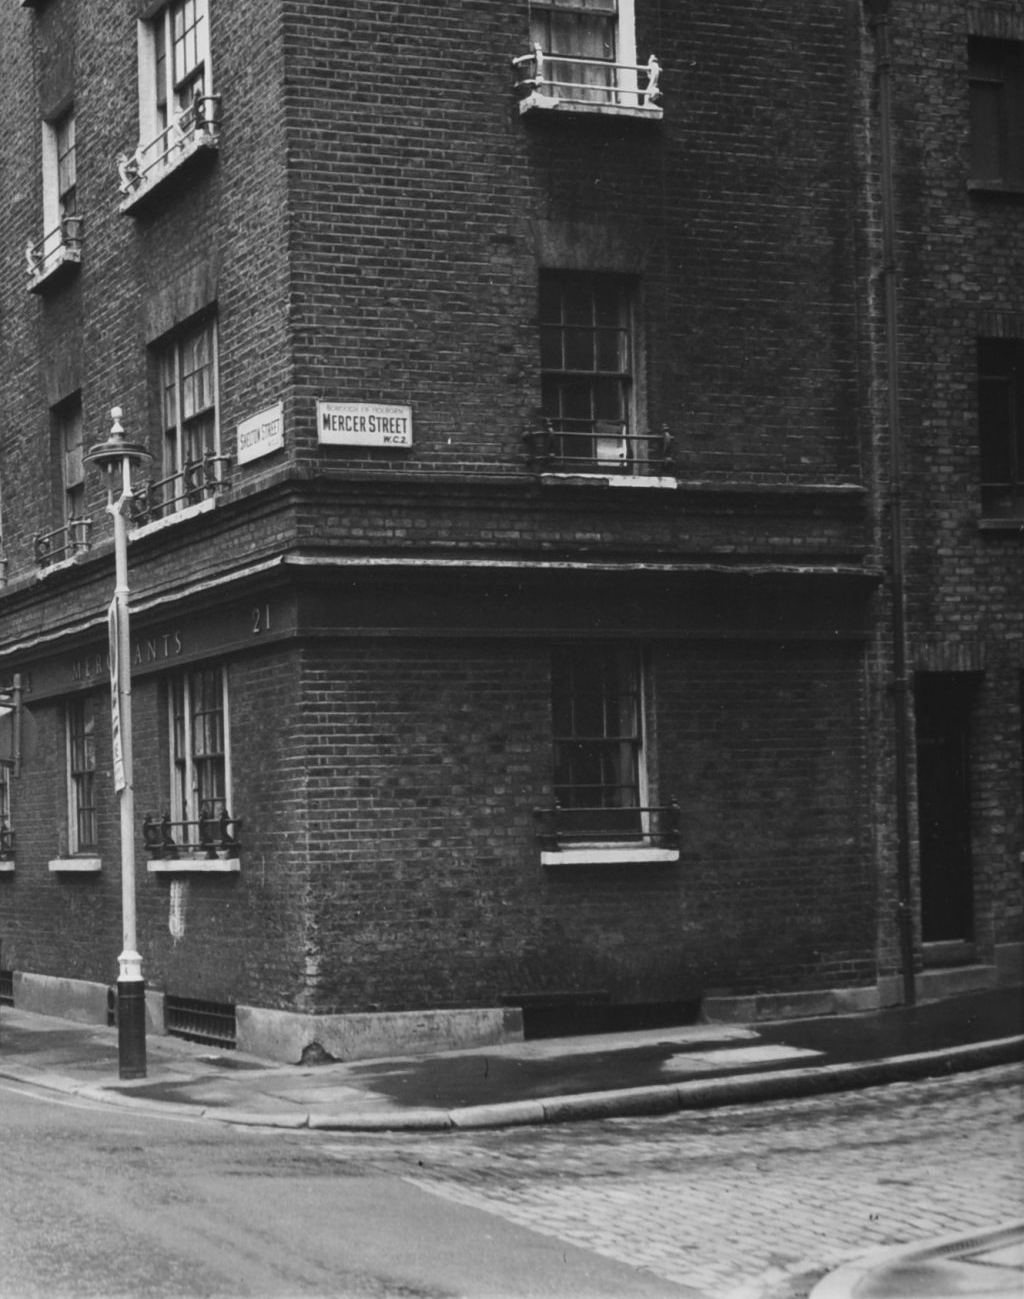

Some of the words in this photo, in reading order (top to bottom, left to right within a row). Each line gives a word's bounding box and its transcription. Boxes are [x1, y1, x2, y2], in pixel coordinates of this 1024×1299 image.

[322, 413, 367, 433] MERCER
[368, 415, 408, 434] STREET
[252, 605, 270, 633] 21
